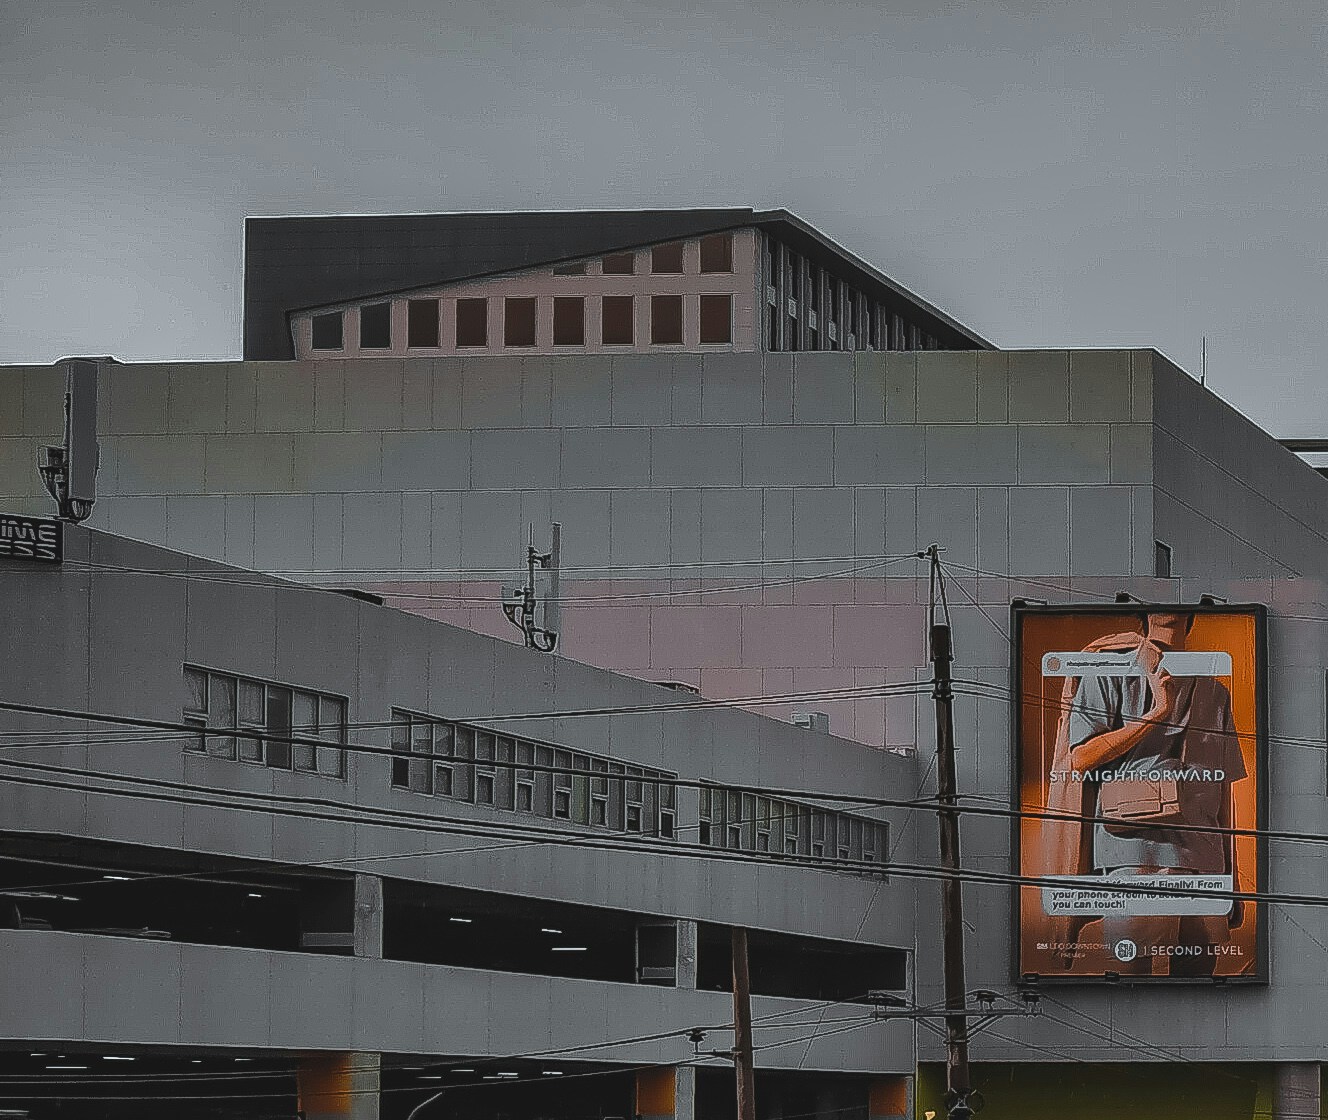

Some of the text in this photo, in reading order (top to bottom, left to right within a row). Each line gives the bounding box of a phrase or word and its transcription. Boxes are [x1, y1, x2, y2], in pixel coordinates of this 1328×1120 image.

[1049, 769, 1226, 783] STRAIGHTFORWARD
[1197, 879, 1223, 889] From
[1052, 891, 1075, 900] your
[1077, 891, 1109, 901] phone
[1052, 900, 1126, 910] you can touch!
[1151, 945, 1203, 956] SECOND
[1207, 945, 1244, 956] LEVEL
